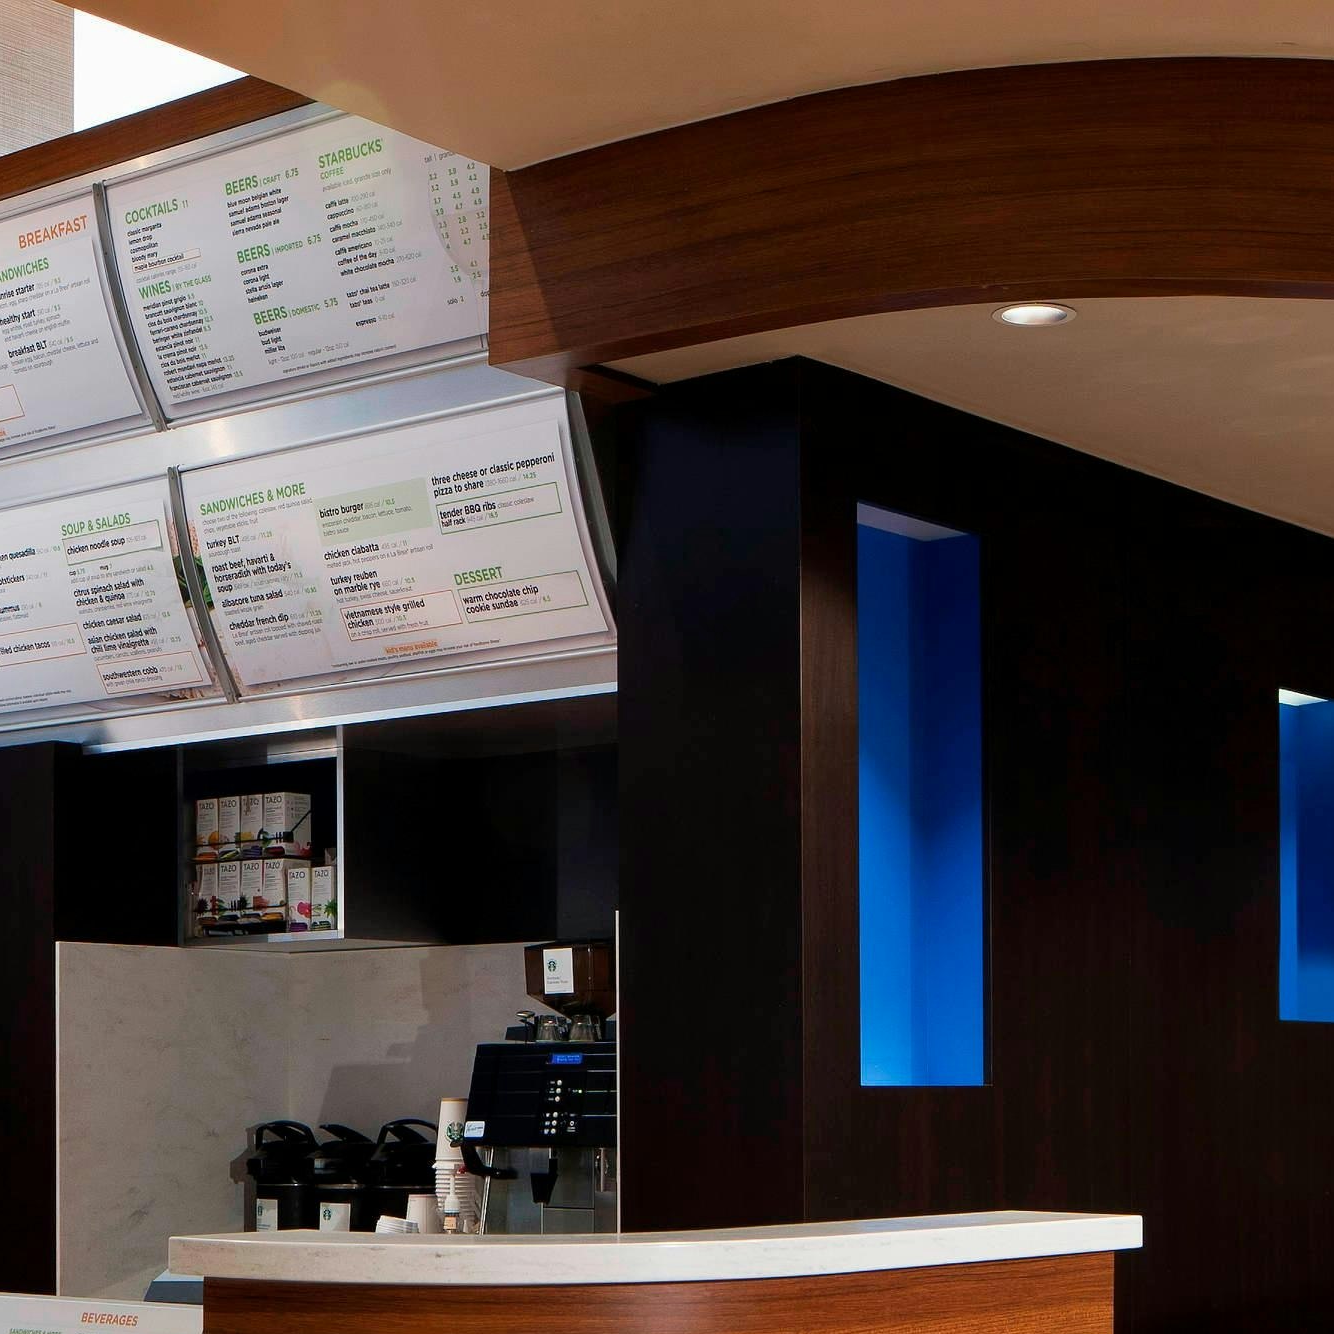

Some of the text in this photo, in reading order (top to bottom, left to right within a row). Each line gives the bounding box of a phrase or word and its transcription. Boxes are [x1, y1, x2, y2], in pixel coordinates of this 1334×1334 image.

[318, 138, 383, 169] STARBUCKS
[225, 167, 299, 196] BEERS CRAFT 6.75
[320, 166, 344, 180] COFFEE
[227, 188, 282, 208] blue moon belgian white
[228, 196, 289, 218] samuel adams boston lager
[125, 198, 179, 224] COCKTAILS
[327, 208, 354, 220] cappuccino
[18, 215, 88, 249] BREAKFAST
[331, 233, 350, 243] caramel
[236, 233, 321, 264] BEERS IMPORTED 6.75
[347, 241, 372, 252] americano
[337, 257, 353, 266] coffee
[353, 254, 359, 262] of
[368, 251, 377, 259] day
[340, 258, 394, 276] white chocolate mocha
[240, 267, 257, 276] corona
[242, 273, 270, 285] corona light
[15, 283, 35, 296] starter
[138, 280, 171, 299] WINES
[194, 275, 212, 285] GLASS
[0, 309, 35, 326] healthy start
[253, 297, 339, 326] BEERS DOMESTIC 5.75
[7, 340, 47, 359] breakfast BLT
[431, 452, 555, 486] three cheese or classic pepperoni
[433, 486, 453, 499] pizza
[454, 483, 463, 492] to
[463, 480, 484, 491] share
[200, 482, 306, 516] SANDWICHES & MORE
[319, 502, 364, 519] bistro burger
[439, 501, 496, 519] tender BBQ ribs
[61, 512, 131, 536] SOUP & SALADS
[453, 517, 466, 525] rack
[66, 537, 125, 555] chicken noodle soup
[206, 538, 226, 549] turkey
[228, 534, 240, 545] BLT
[323, 542, 380, 561] chicken ciabatta
[211, 562, 228, 573] roast
[246, 554, 269, 565] havarti
[270, 553, 275, 561] &
[213, 561, 291, 583] horseradish with today's
[330, 570, 378, 586] turkey reuben
[453, 566, 502, 585] DESSERT
[333, 581, 380, 596] on marble rye
[463, 585, 539, 604] warm chocolate chip
[343, 598, 425, 620] vietnamese style grilled
[466, 599, 519, 614] cookie sundae
[229, 612, 289, 631] cheddar french dip
[102, 665, 158, 681] southwestern cobb
[221, 799, 237, 808] TAZO
[265, 795, 282, 803] TAZO
[220, 864, 237, 873] TAZO
[243, 862, 260, 871] TAZO
[288, 871, 305, 879] TAZO
[314, 869, 329, 877] TAZO
[81, 1312, 138, 1326] BEVERAGES
